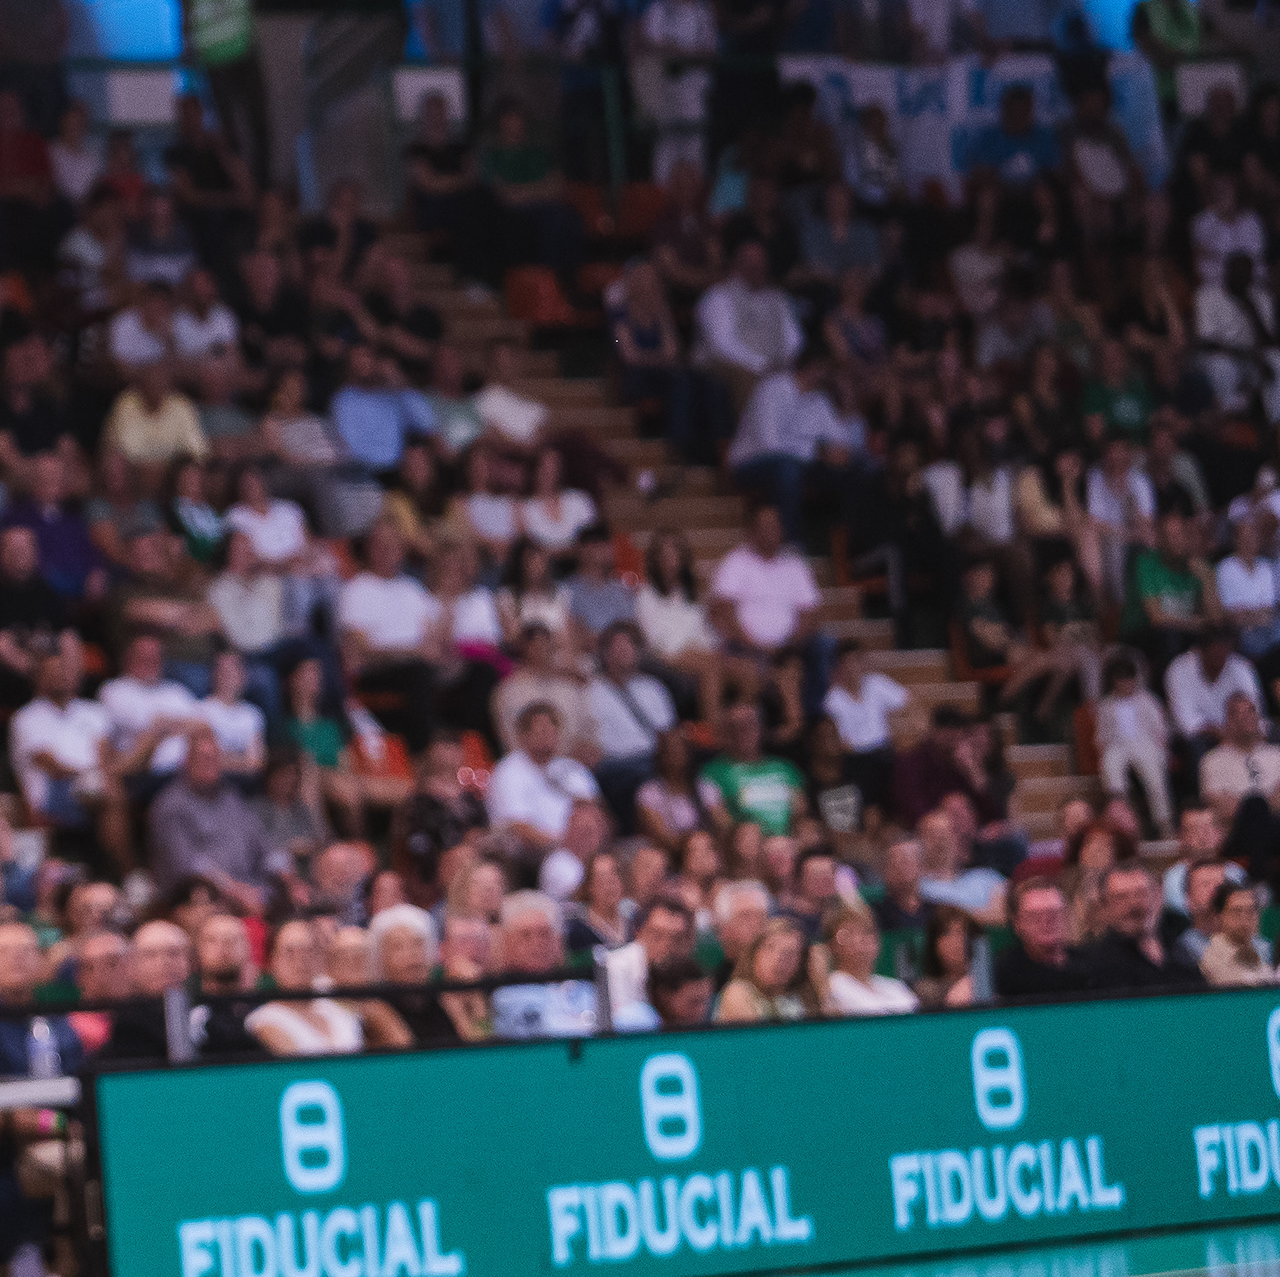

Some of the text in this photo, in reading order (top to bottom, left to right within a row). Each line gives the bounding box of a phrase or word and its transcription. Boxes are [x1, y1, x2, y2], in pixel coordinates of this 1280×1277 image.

[545, 1165, 814, 1267] FIDUCIAL
[888, 1133, 1126, 1232] FIDUCIAL
[177, 1198, 465, 1277] FIDUCIAL
